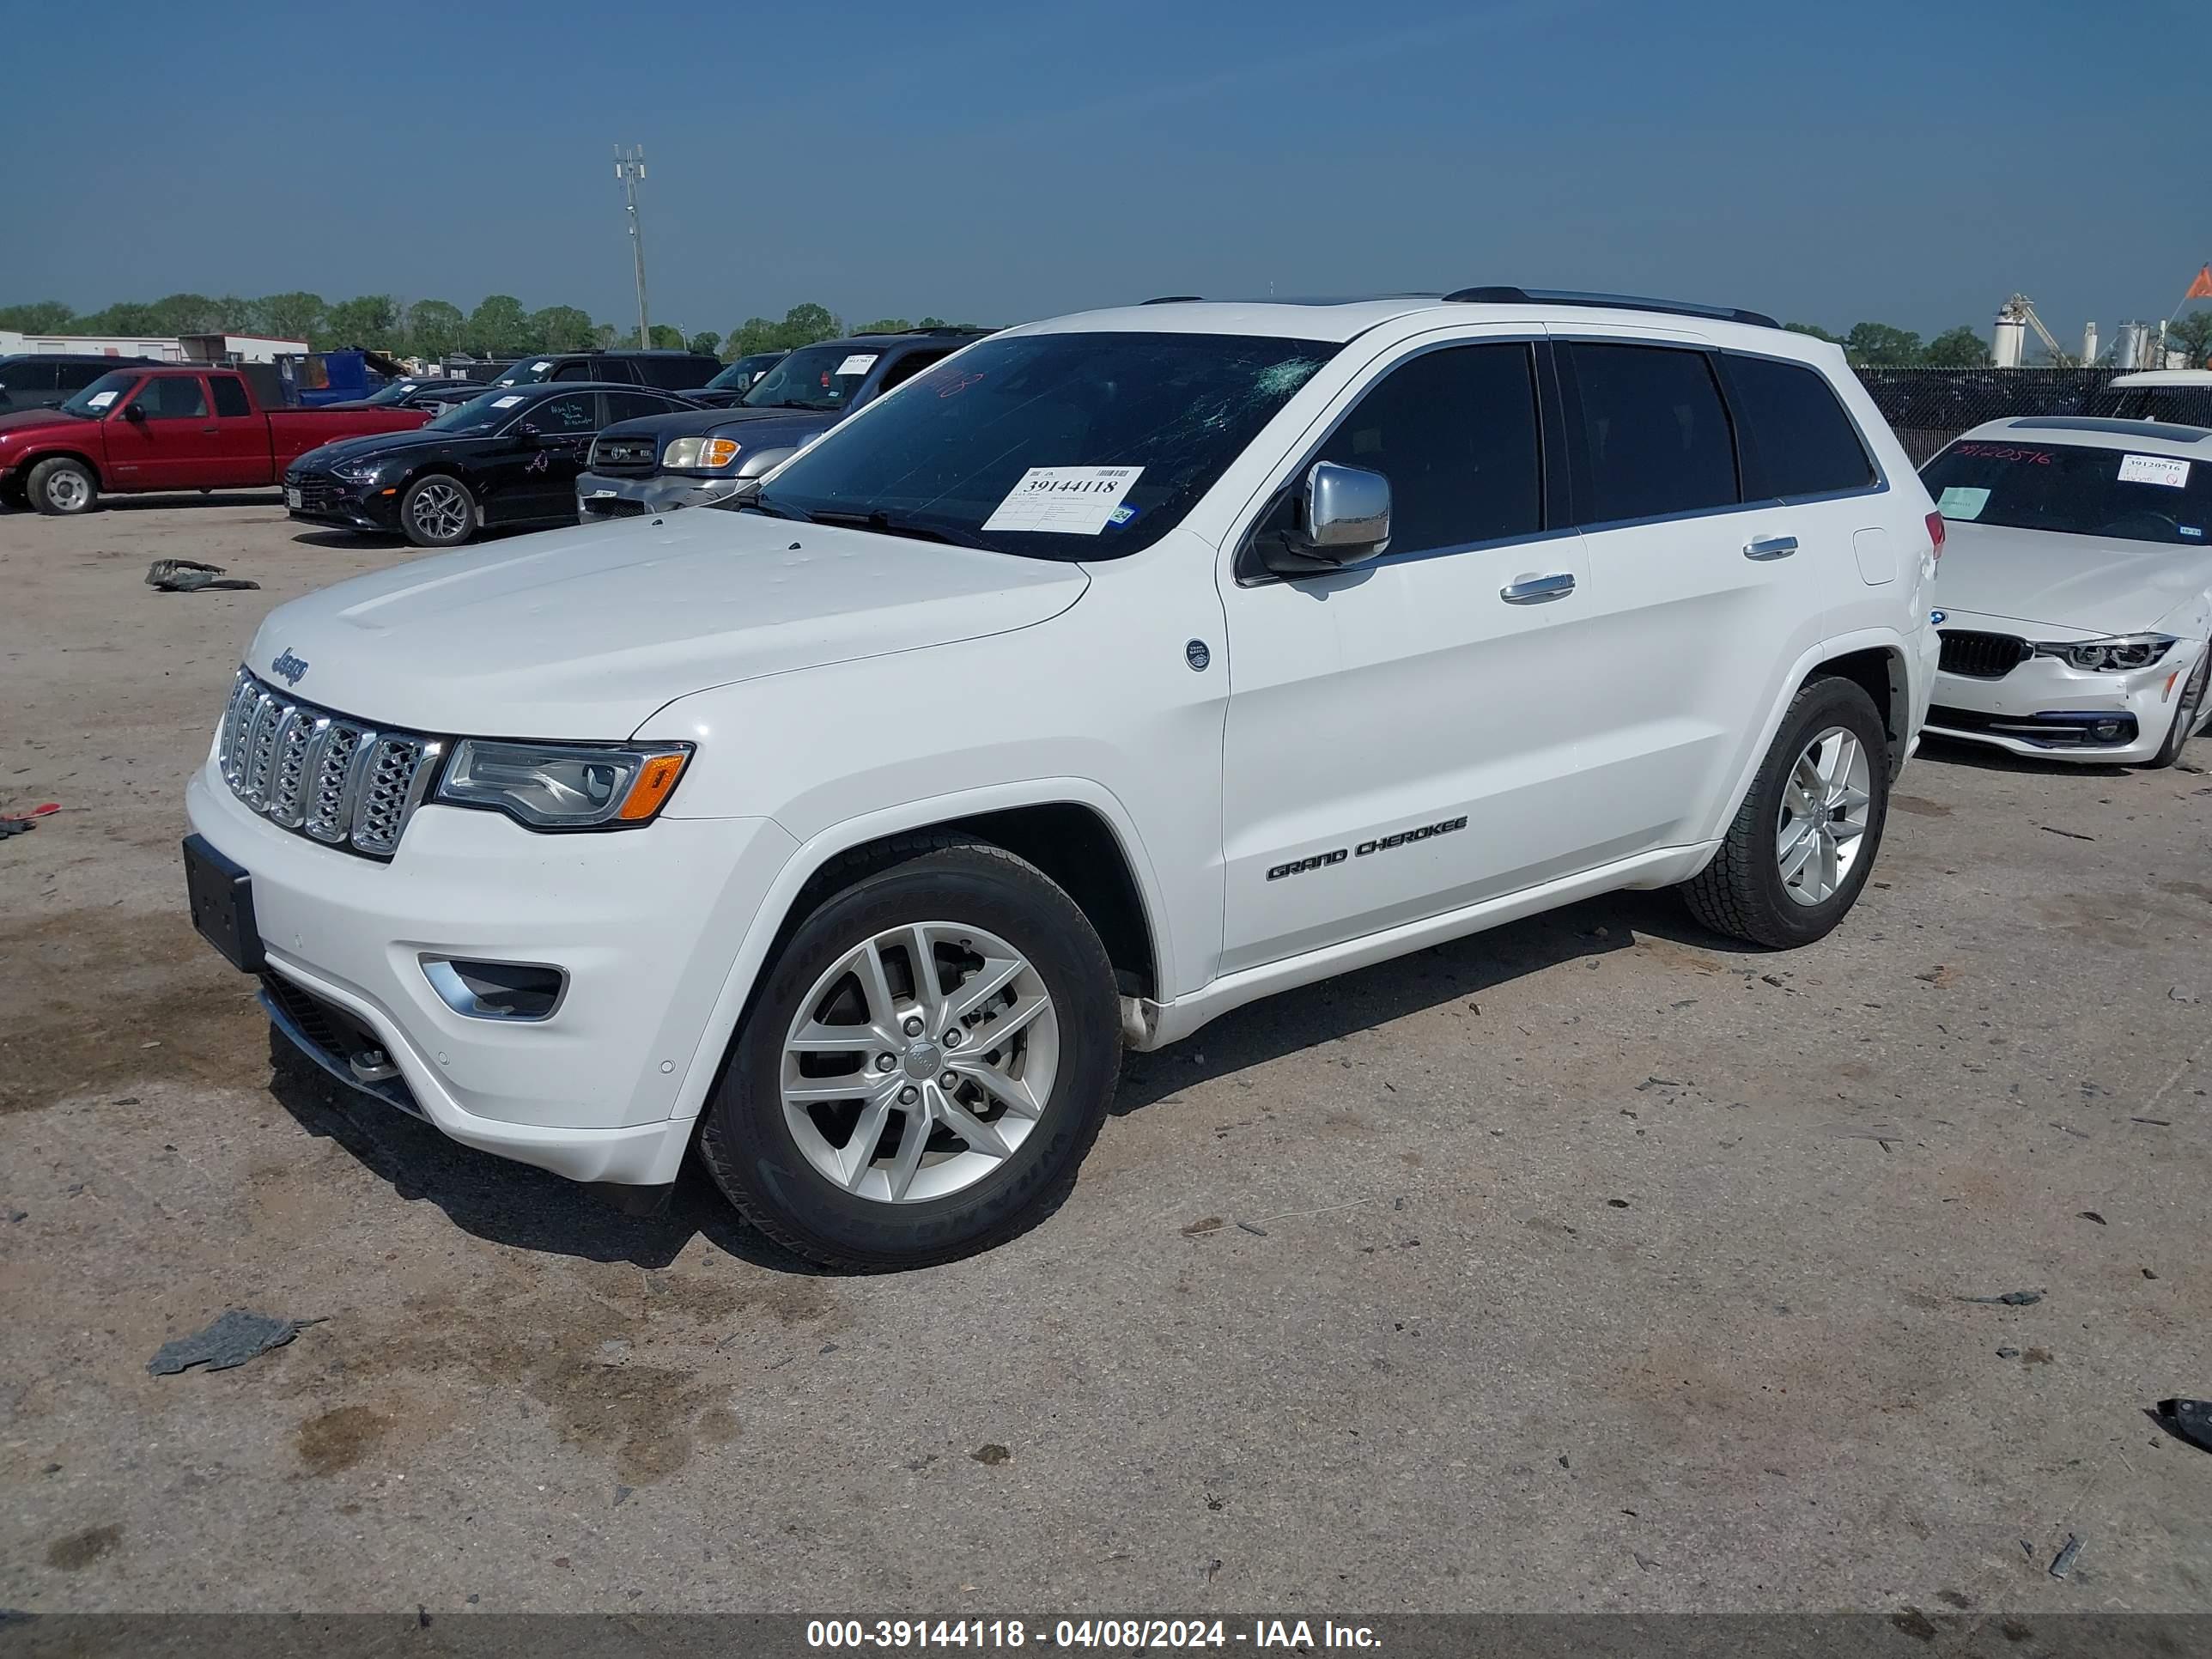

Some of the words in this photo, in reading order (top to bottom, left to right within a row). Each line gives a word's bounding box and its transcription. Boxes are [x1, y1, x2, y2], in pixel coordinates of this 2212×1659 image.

[1024, 480, 1118, 494] 39144118
[271, 647, 309, 687] Jeep
[1266, 848, 1348, 882] GRAND
[1354, 815, 1468, 857] CHEROKEE
